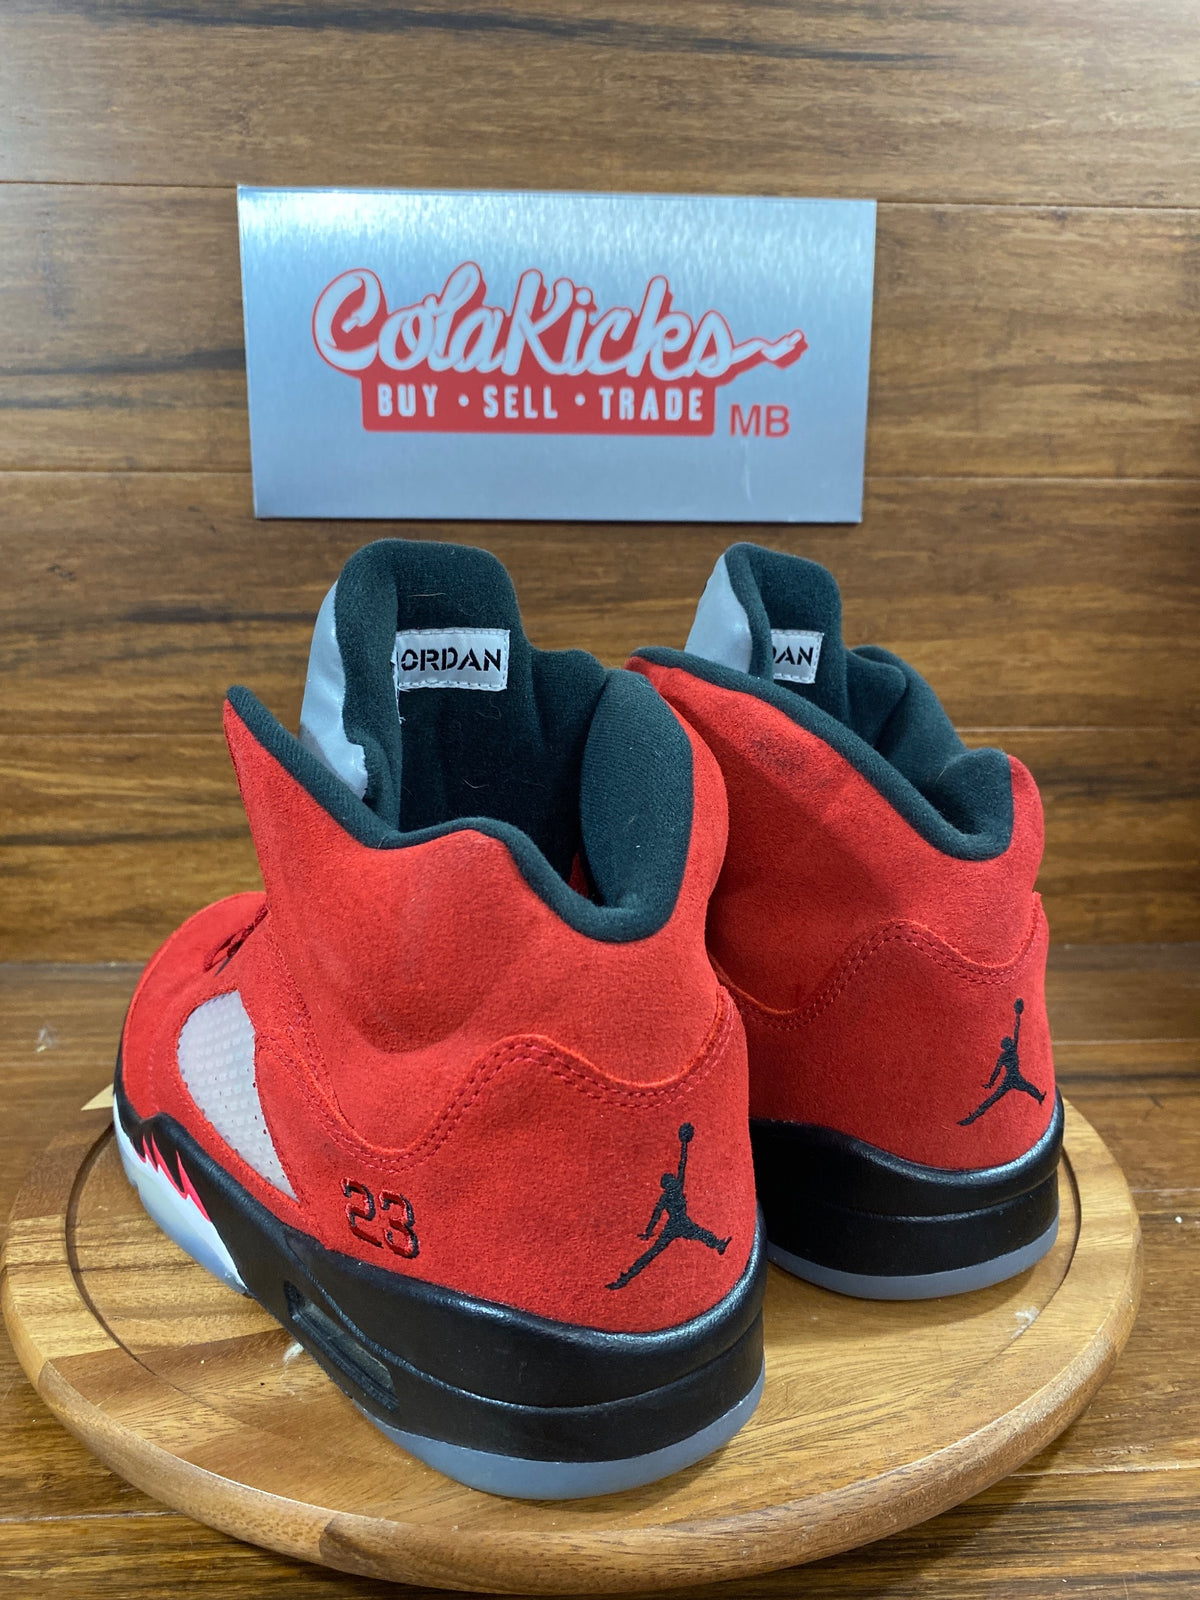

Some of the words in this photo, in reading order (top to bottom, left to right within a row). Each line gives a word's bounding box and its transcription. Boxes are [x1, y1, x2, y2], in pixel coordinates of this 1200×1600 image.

[312, 261, 808, 381] ColaKicks
[377, 384, 438, 419] BUY
[482, 385, 559, 420] SELL
[599, 386, 704, 422] TRADE
[730, 403, 791, 438] MB
[396, 647, 502, 672] ORDAN
[340, 1178, 420, 1259] 23
